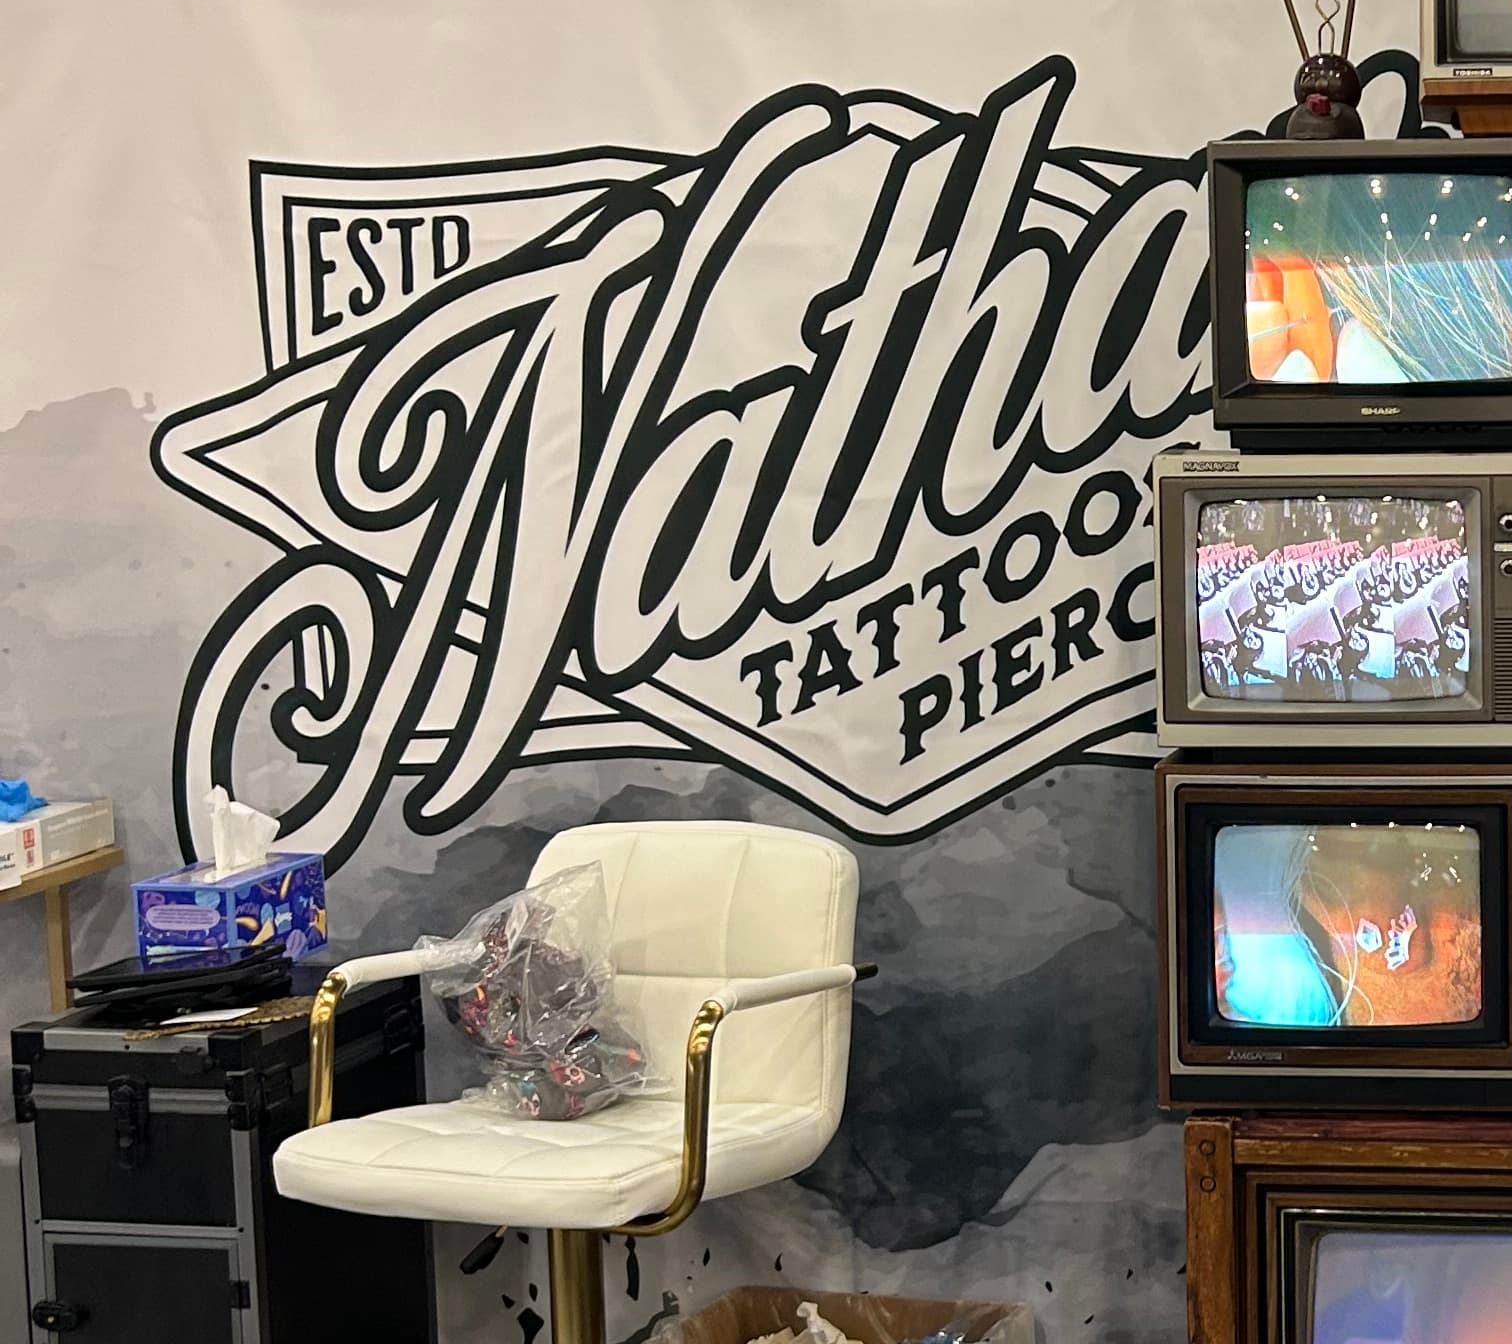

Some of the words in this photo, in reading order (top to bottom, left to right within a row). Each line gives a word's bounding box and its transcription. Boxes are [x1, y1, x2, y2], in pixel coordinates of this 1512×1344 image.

[307, 213, 472, 335] ESTD
[172, 54, 1212, 871] Natha
[1182, 460, 1240, 473] MAGNAVOX
[1361, 407, 1401, 416] SHARP
[740, 451, 1155, 728] TATTOO
[899, 561, 1156, 766] PIERC
